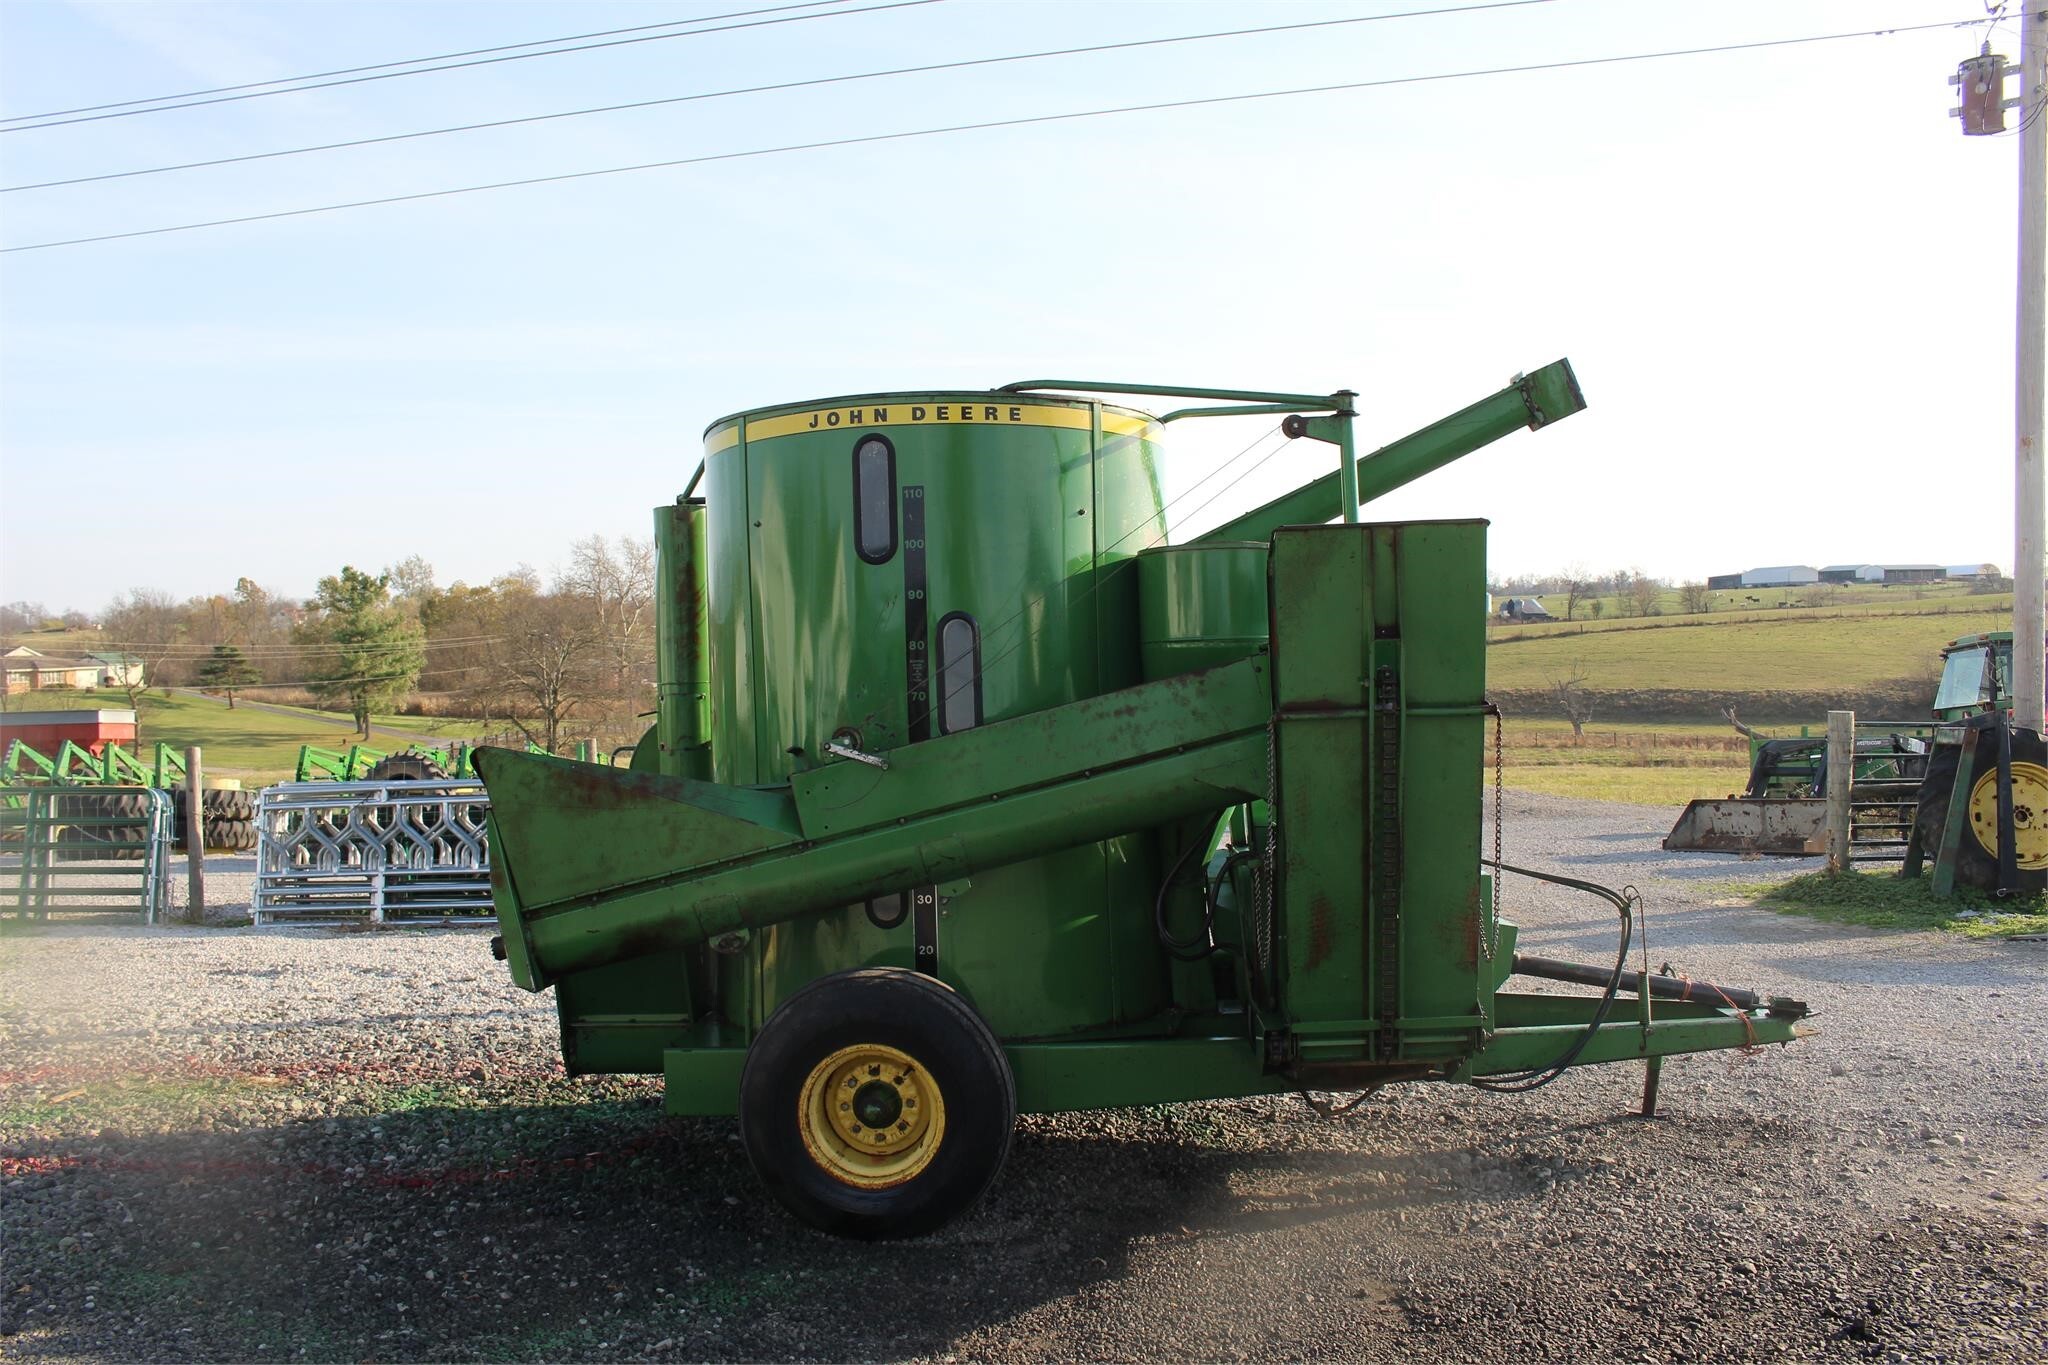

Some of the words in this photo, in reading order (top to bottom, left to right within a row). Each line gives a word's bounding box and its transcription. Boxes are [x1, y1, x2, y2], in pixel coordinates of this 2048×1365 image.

[809, 408, 888, 428] JOHN
[911, 406, 1022, 422] DEERE
[903, 489, 923, 498] 110
[904, 540, 925, 549] 100
[908, 590, 924, 600] 90
[909, 641, 925, 650] 80
[911, 691, 926, 701] 70
[917, 894, 933, 904] 30
[919, 945, 933, 955] 20
